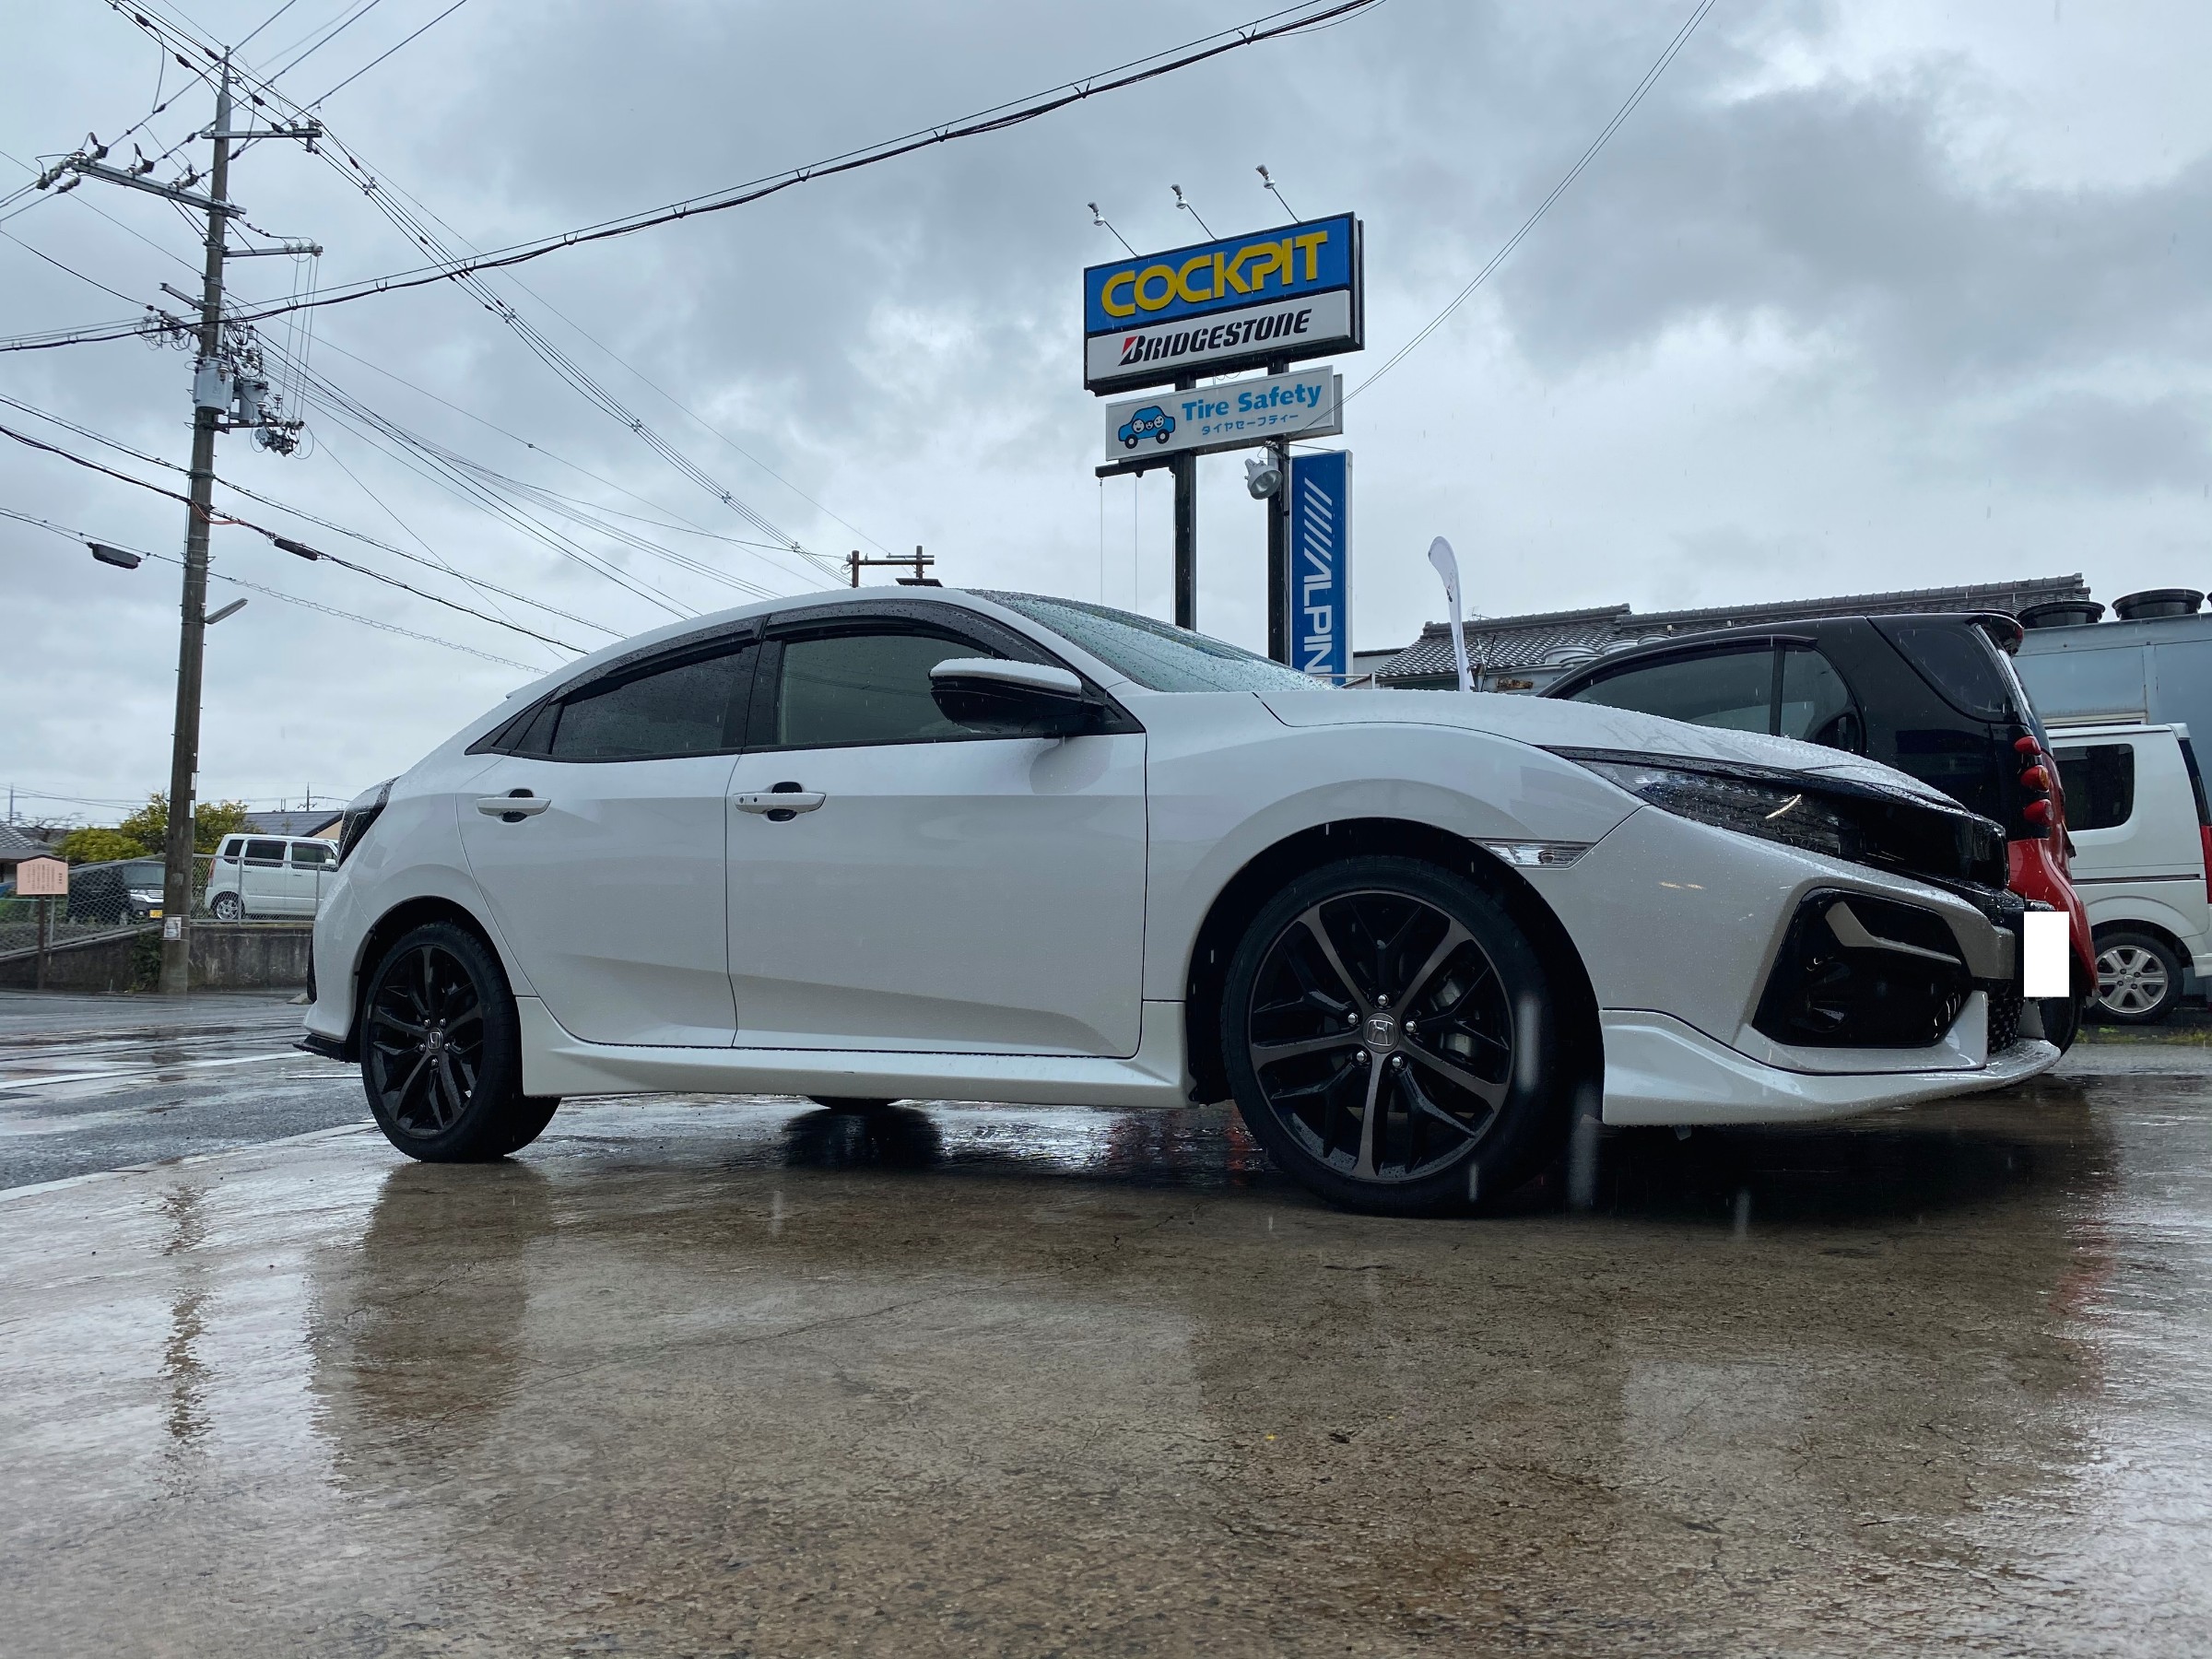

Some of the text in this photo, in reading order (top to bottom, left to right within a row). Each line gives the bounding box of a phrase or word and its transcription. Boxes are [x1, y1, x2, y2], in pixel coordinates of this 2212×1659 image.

[1101, 230, 1328, 317] COCKPIT
[1117, 308, 1312, 367] BRIDGESTONE
[1182, 383, 1323, 421] Tire Safety
[1201, 414, 1299, 436] タイヤセーフティー
[1303, 547, 1333, 685] ALPIN
